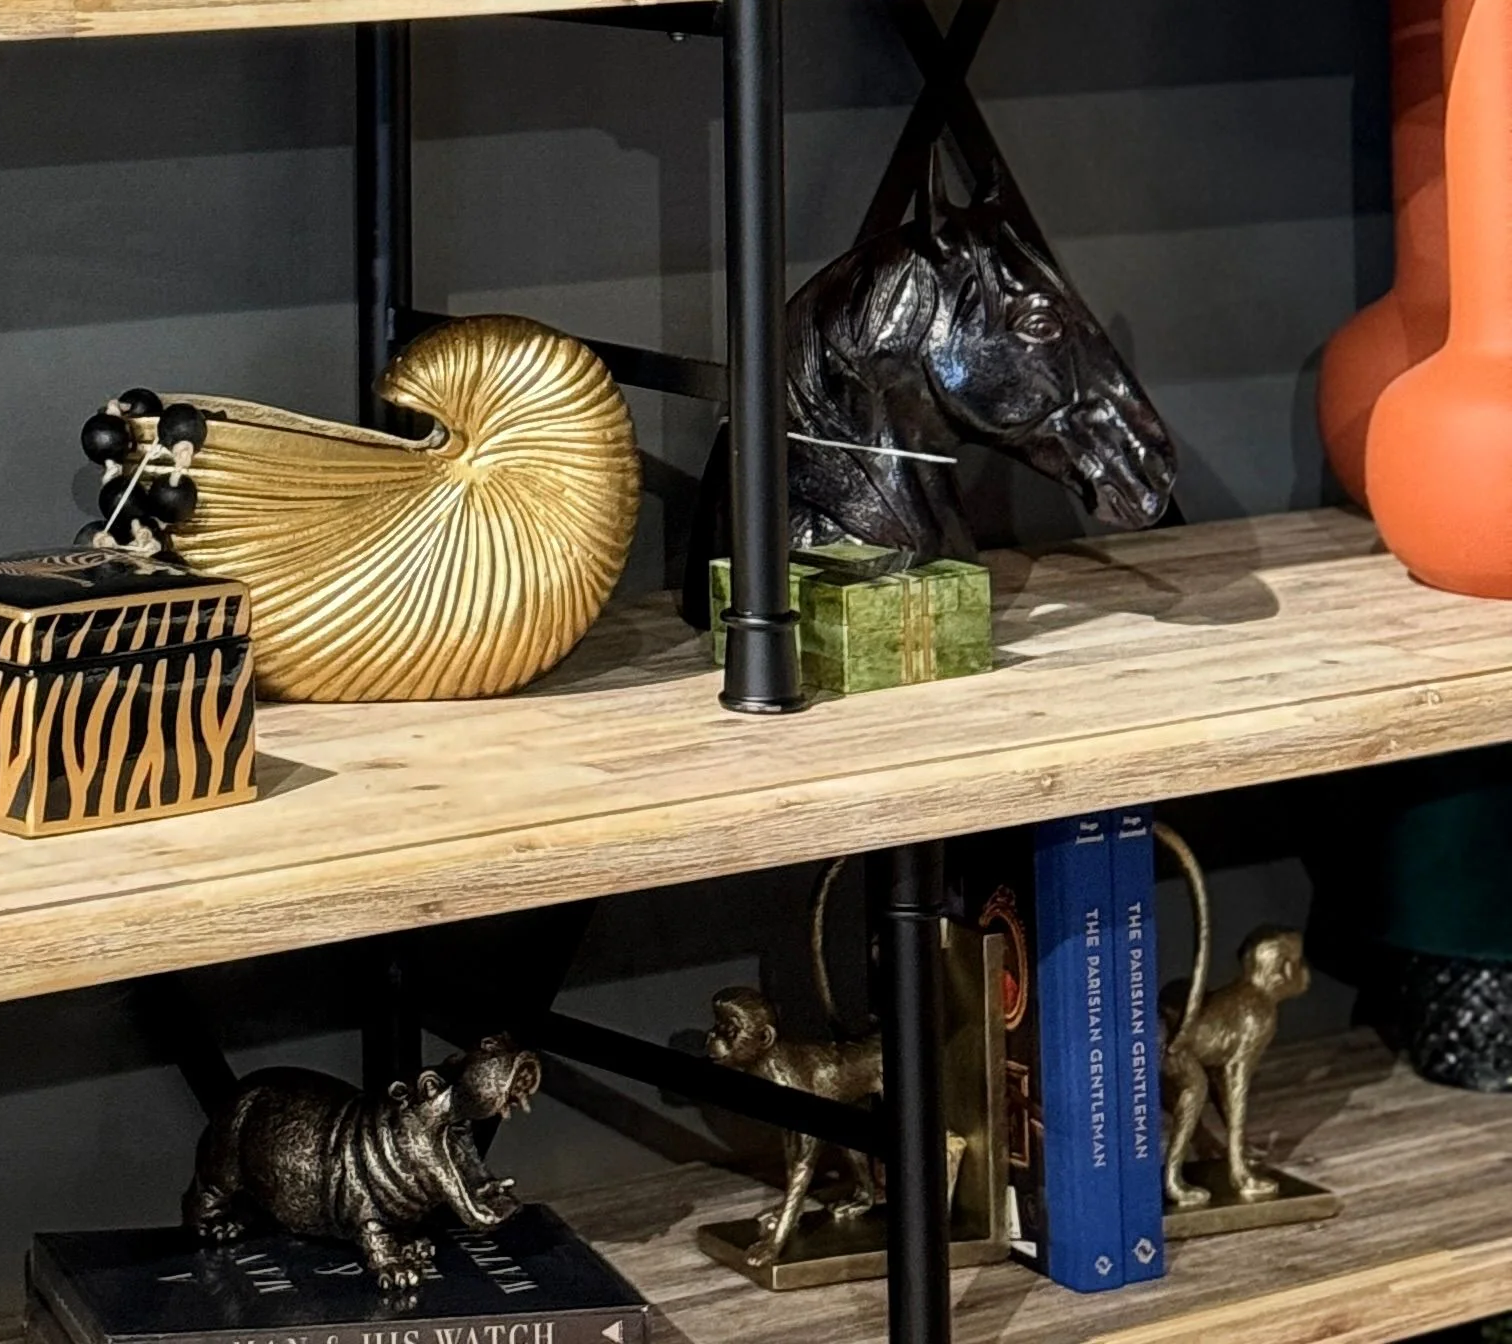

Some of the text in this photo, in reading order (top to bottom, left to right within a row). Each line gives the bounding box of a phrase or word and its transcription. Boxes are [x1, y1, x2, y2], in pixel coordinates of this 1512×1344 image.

[1086, 908, 1107, 1168] THE PARISIAN GENTLEMAN
[1128, 901, 1148, 1159] THE PARISIAN GENTLEMAN
[433, 1322, 555, 1344] WATCH
